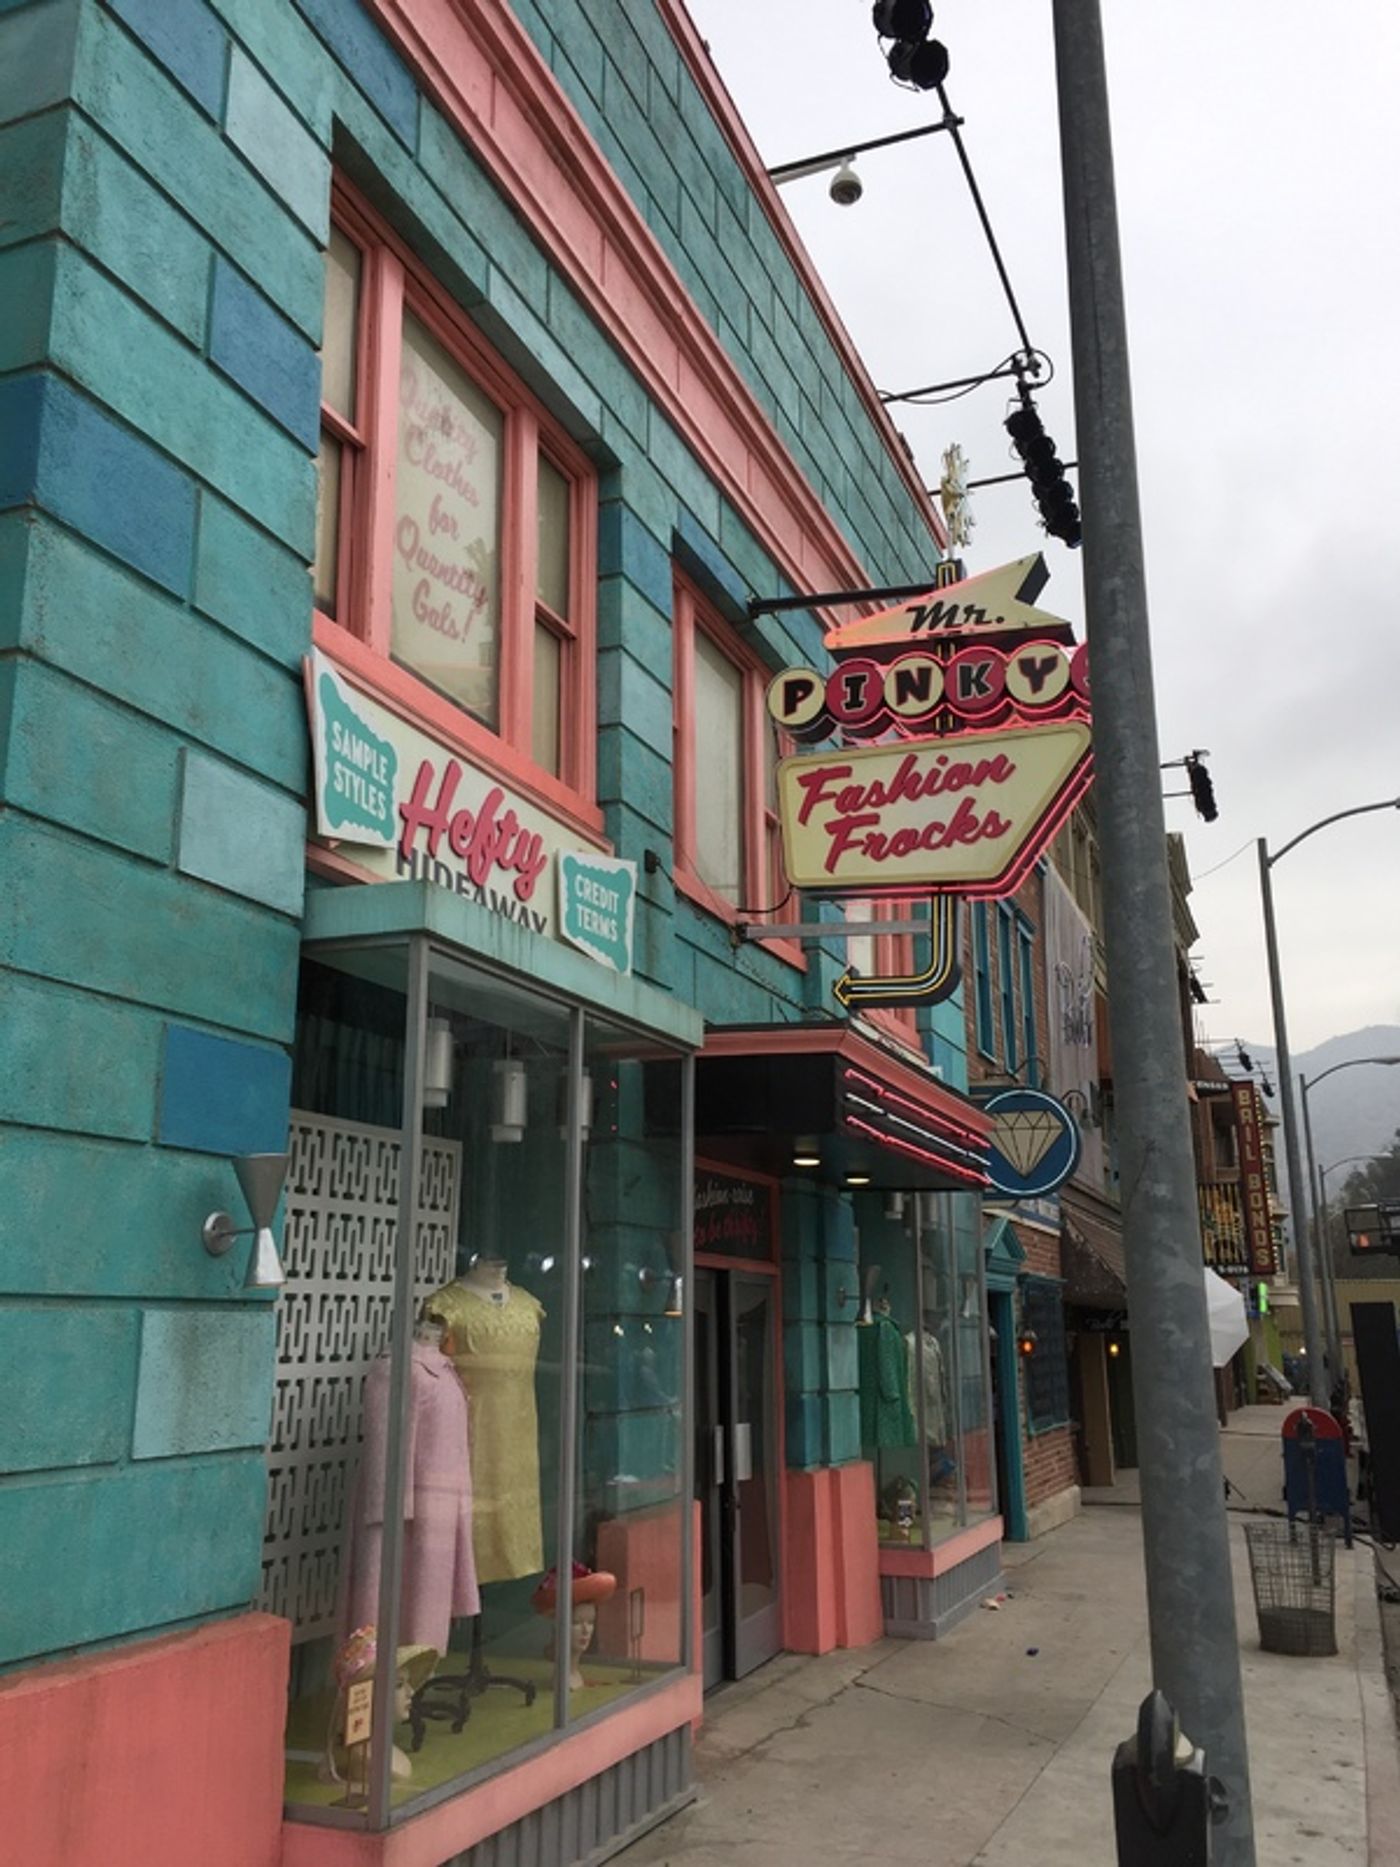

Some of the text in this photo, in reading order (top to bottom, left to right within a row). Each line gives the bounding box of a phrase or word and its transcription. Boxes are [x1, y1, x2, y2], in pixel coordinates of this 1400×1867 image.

[403, 424, 479, 508] Clothes
[429, 494, 460, 541] for
[397, 517, 488, 609] Quantity
[411, 581, 475, 643] Gals!
[905, 599, 1006, 633] Mr.
[782, 654, 1089, 718] PINKY
[331, 719, 389, 787] SAMPLE
[333, 761, 387, 821] STYLES
[797, 750, 1016, 827] Fashion
[399, 759, 548, 902] Hefty
[824, 797, 1012, 875] Frocks
[574, 874, 620, 913] CREDIT
[575, 906, 619, 943] TERMS
[1236, 1088, 1271, 1268] BAIL BONDS
